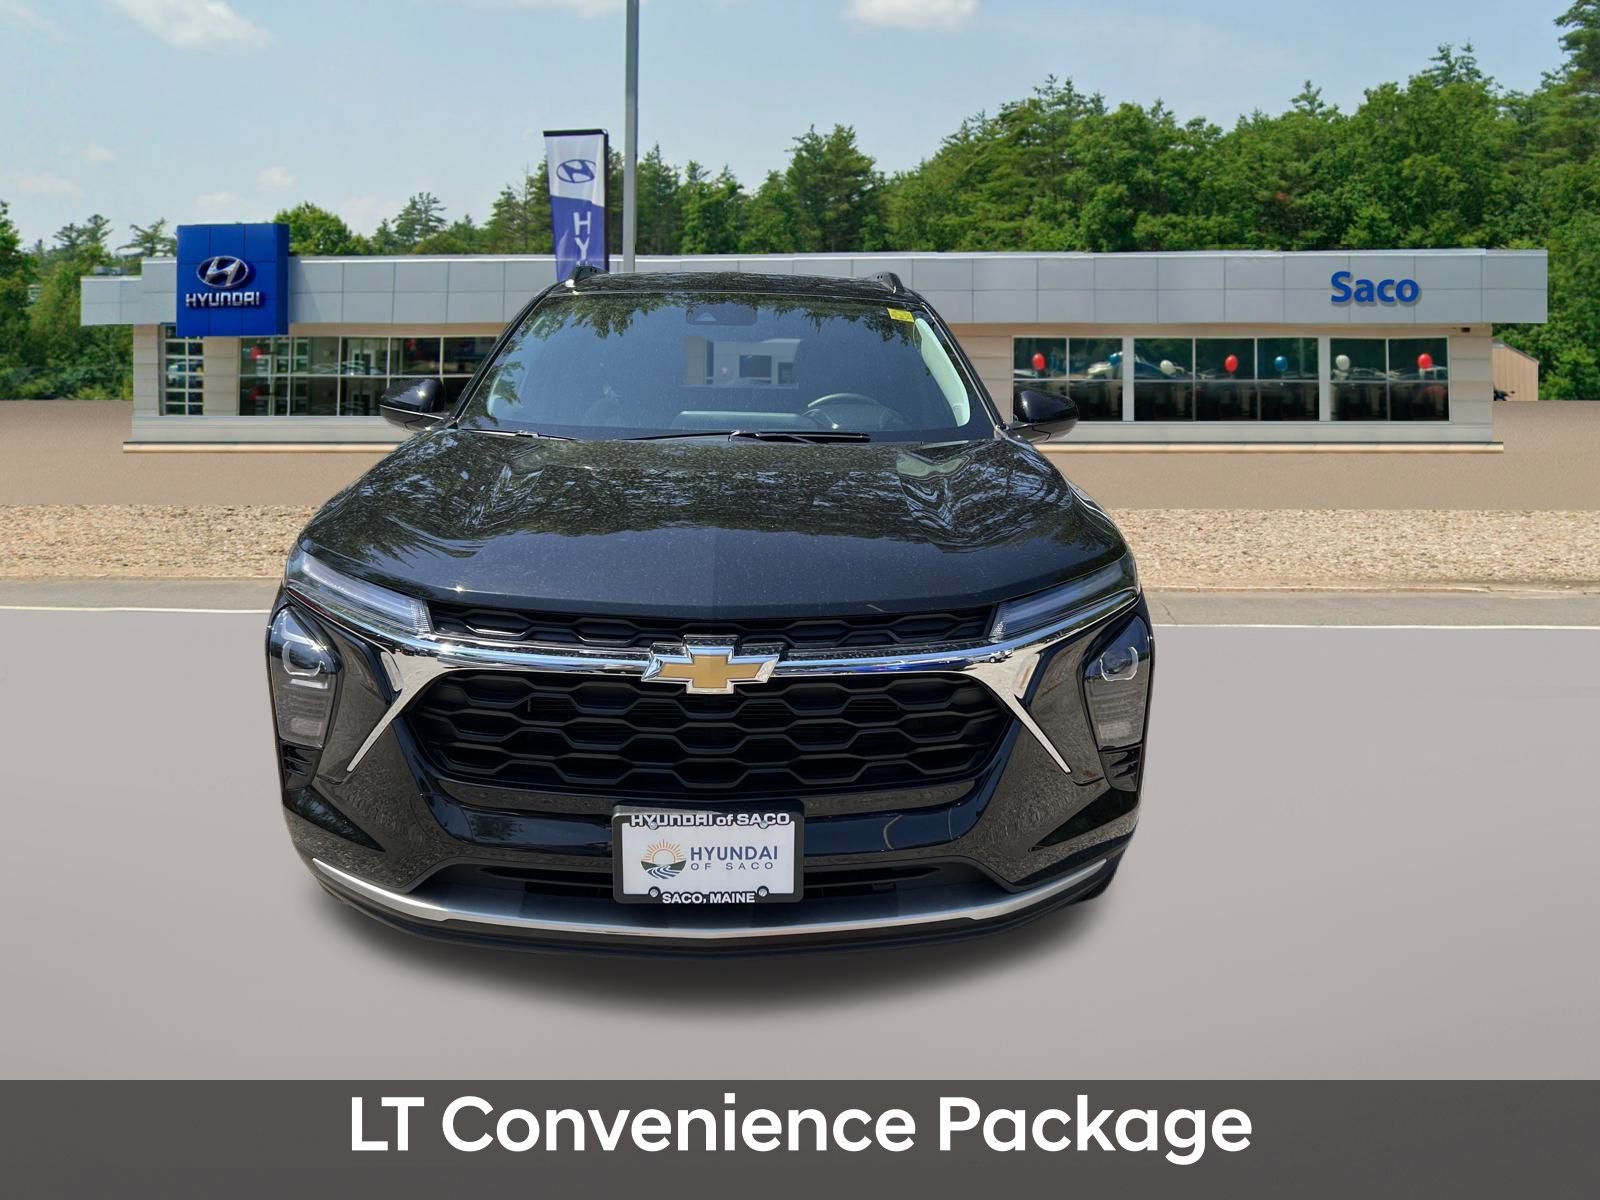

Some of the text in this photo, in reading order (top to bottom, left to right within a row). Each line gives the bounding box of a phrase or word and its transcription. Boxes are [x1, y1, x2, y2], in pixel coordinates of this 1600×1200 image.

[573, 210, 592, 266] HY
[1330, 270, 1420, 303] Saco
[185, 291, 260, 308] HYUNDAI
[631, 813, 790, 827] HYUNDAI of SACO
[690, 845, 778, 861] HYUNDAI
[690, 862, 774, 871] OF SACO
[662, 892, 756, 904] SACO, MAINE
